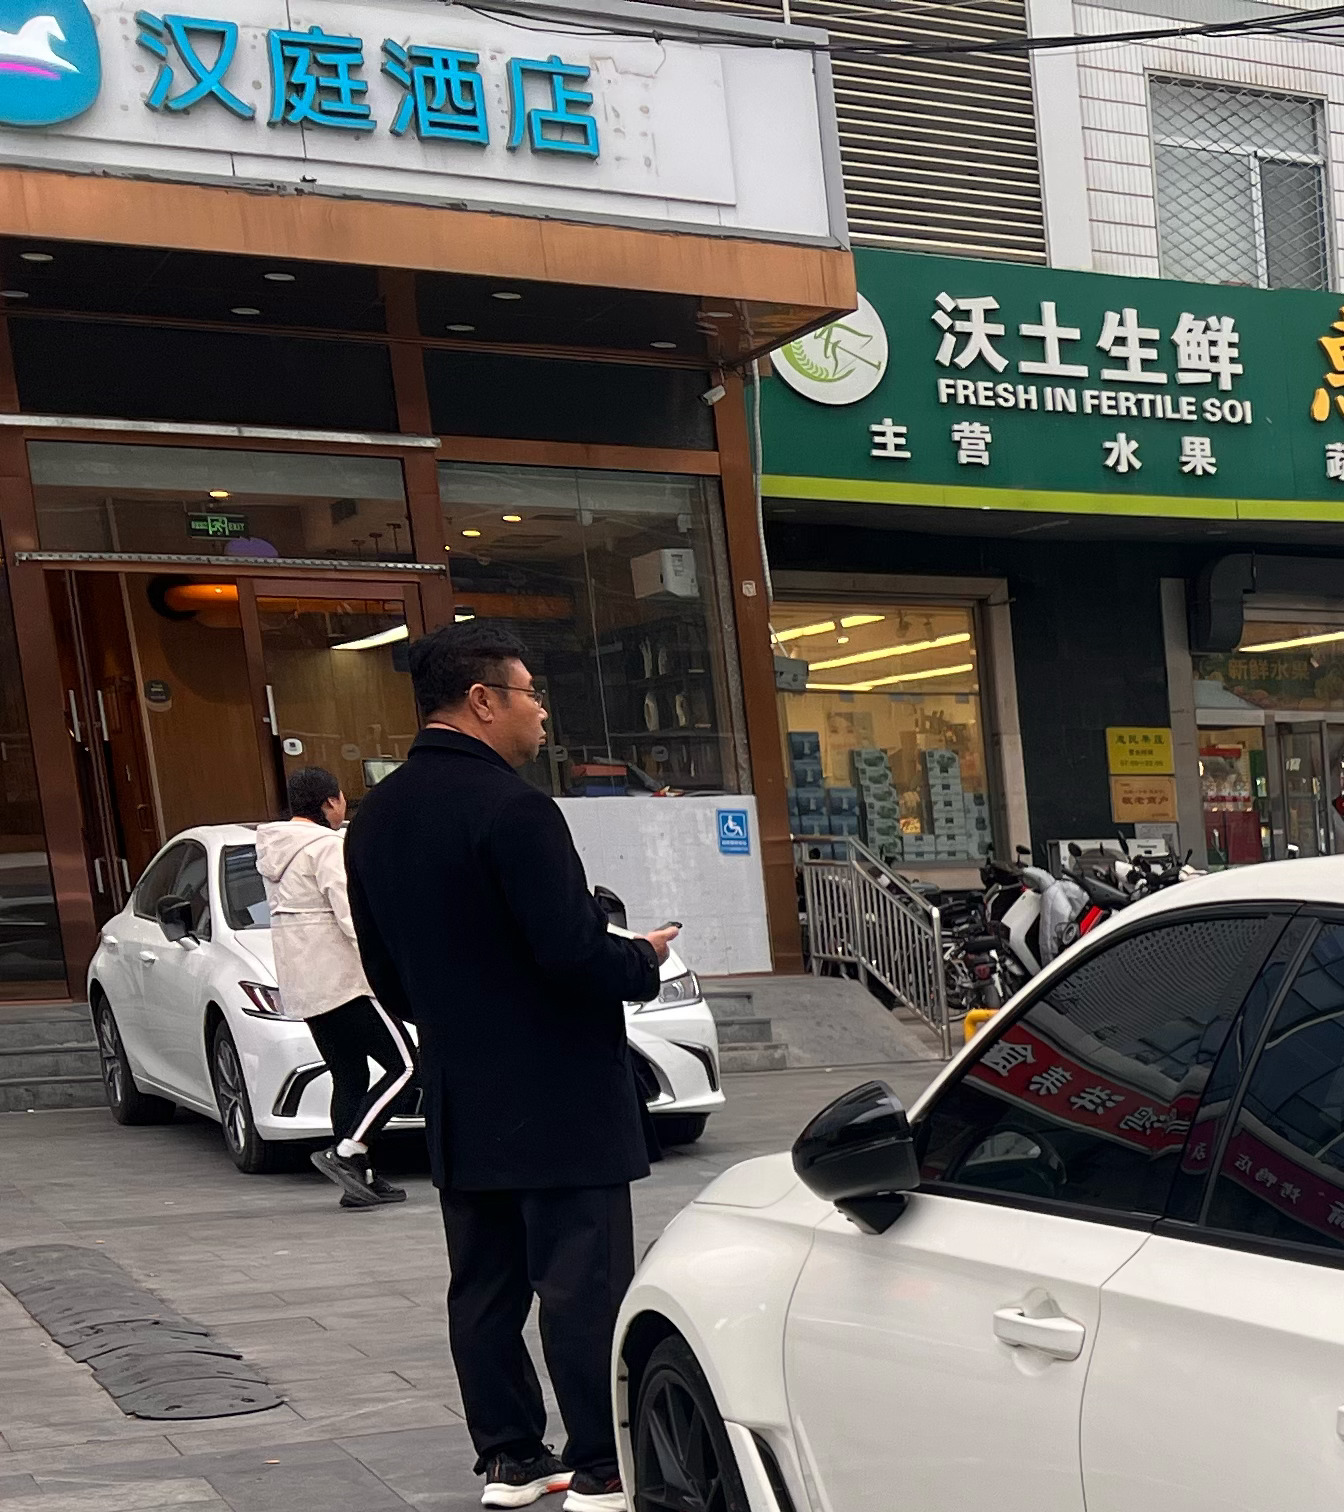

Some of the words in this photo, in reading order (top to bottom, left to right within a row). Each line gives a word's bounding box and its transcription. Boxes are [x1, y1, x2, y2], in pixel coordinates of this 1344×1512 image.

[136, 10, 601, 159] 汉庭酒店
[931, 291, 1244, 391] 沃土生鲜
[939, 379, 1037, 411] FRESH
[1044, 386, 1077, 414] IN
[1082, 389, 1197, 421] FERTILE
[1203, 396, 1253, 425] SOI
[869, 418, 993, 467] 主营
[1102, 432, 1218, 477] 水果
[1228, 658, 1310, 681] 新鲜水果
